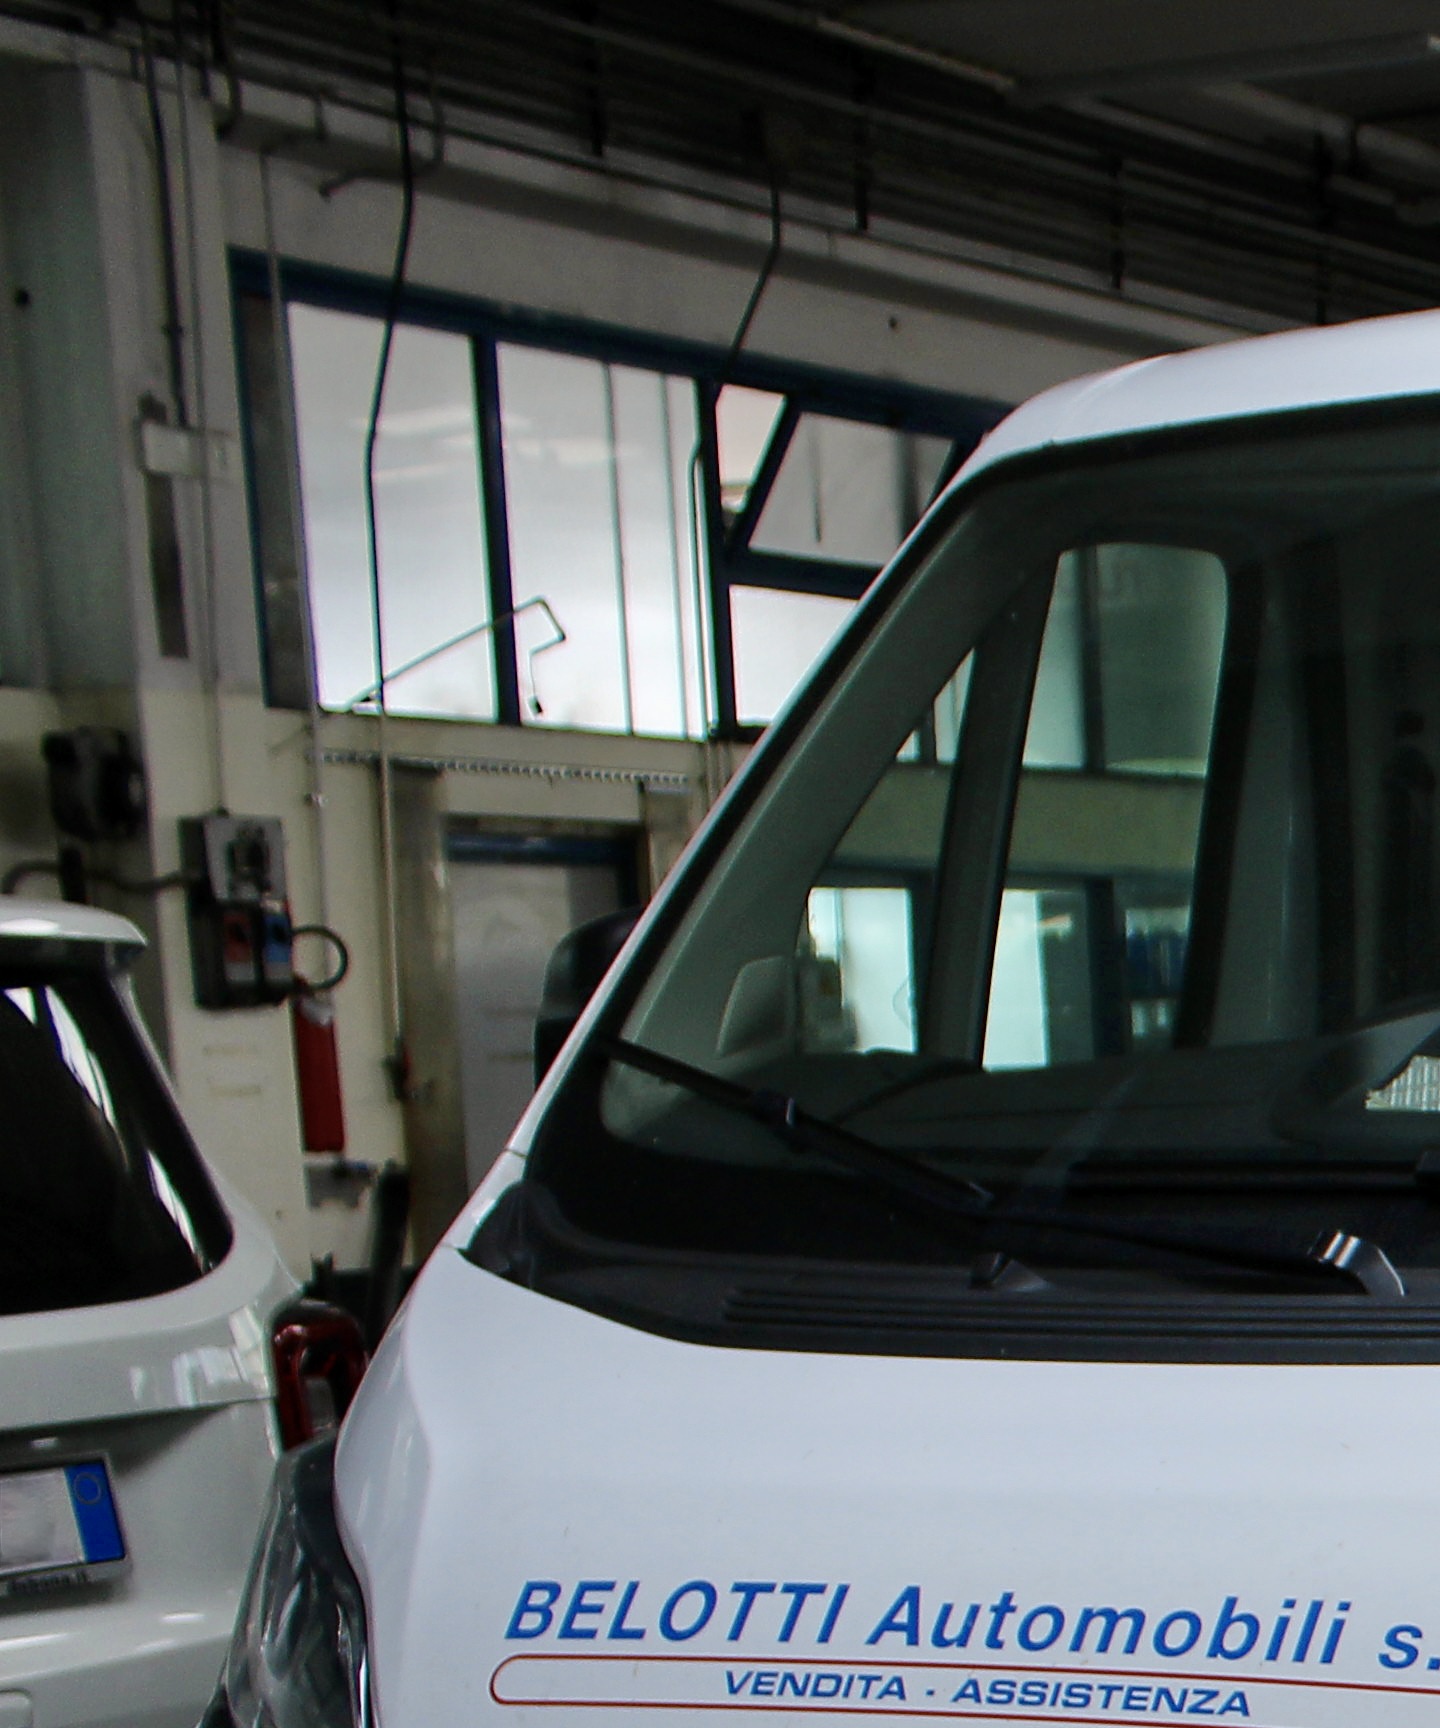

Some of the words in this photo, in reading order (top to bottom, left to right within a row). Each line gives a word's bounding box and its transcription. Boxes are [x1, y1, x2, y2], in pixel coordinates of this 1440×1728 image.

[504, 1580, 850, 1643] BELOTTI
[865, 1585, 1351, 1664] Automobili
[725, 1670, 907, 1701] VENDITA
[952, 1679, 1251, 1717] ASSISTENZA
